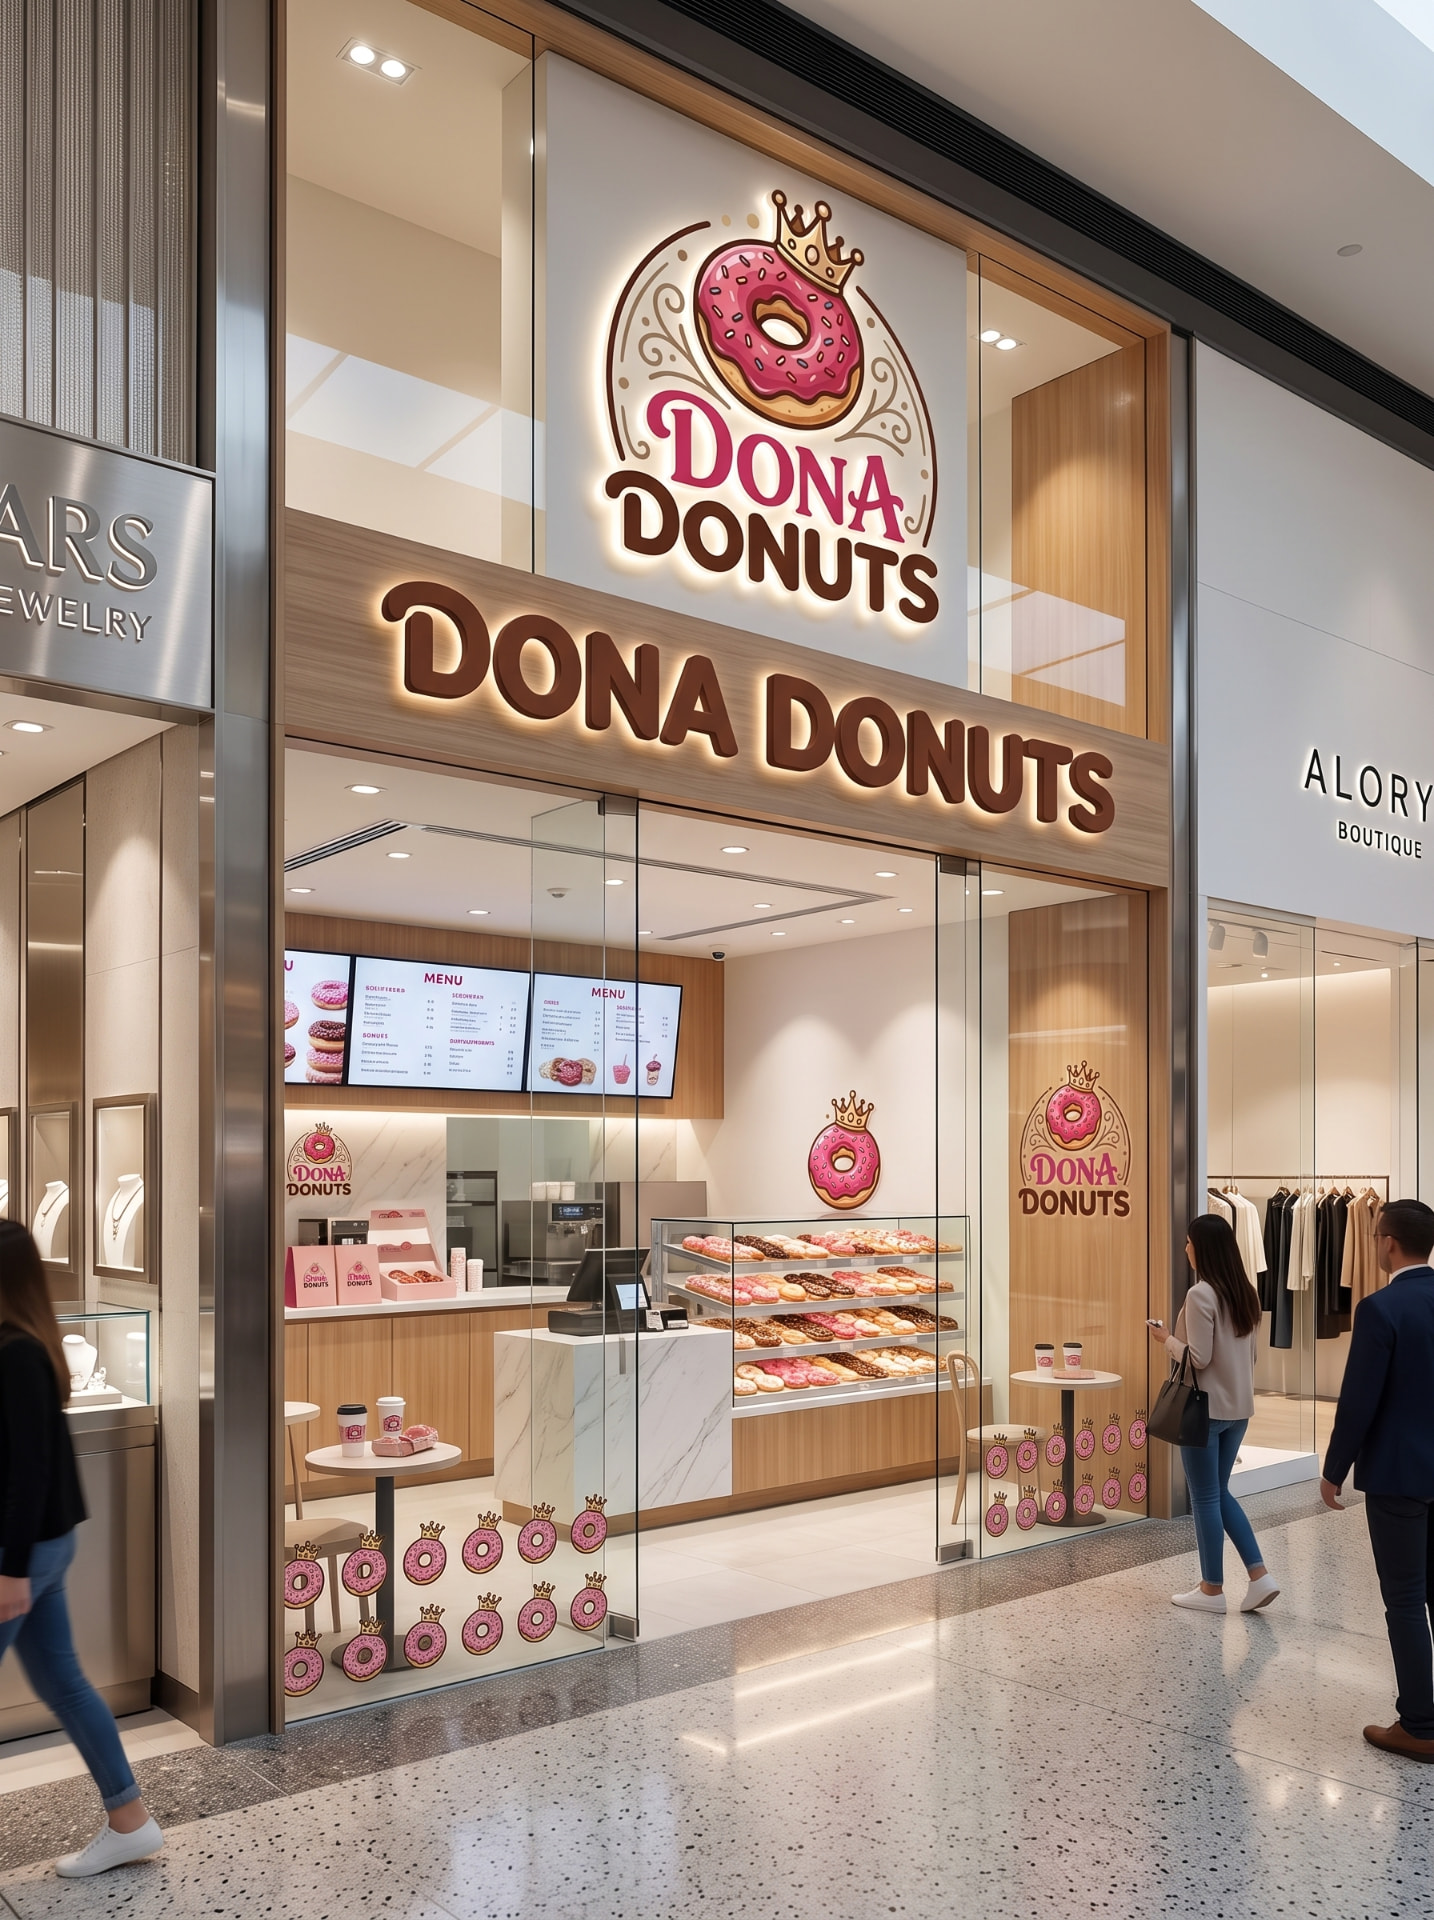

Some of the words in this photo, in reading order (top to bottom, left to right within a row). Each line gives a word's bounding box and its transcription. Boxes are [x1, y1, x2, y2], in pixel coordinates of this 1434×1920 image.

[647, 390, 905, 544] DONA
[605, 470, 940, 623] DONUTS
[382, 581, 738, 758] DONA
[766, 673, 1115, 833] DONUTS
[1304, 748, 1433, 822] ALORY
[1338, 820, 1422, 859] BOUTIQUE
[424, 972, 463, 986] MENU
[591, 987, 626, 1000] MENU
[293, 1164, 346, 1182] DONA
[1030, 1152, 1118, 1186] DONA
[286, 1183, 352, 1196] DONUTS
[1018, 1188, 1131, 1217] DONUTS
[303, 1281, 329, 1289] DONUTS
[346, 1279, 373, 1287] DONUTS
